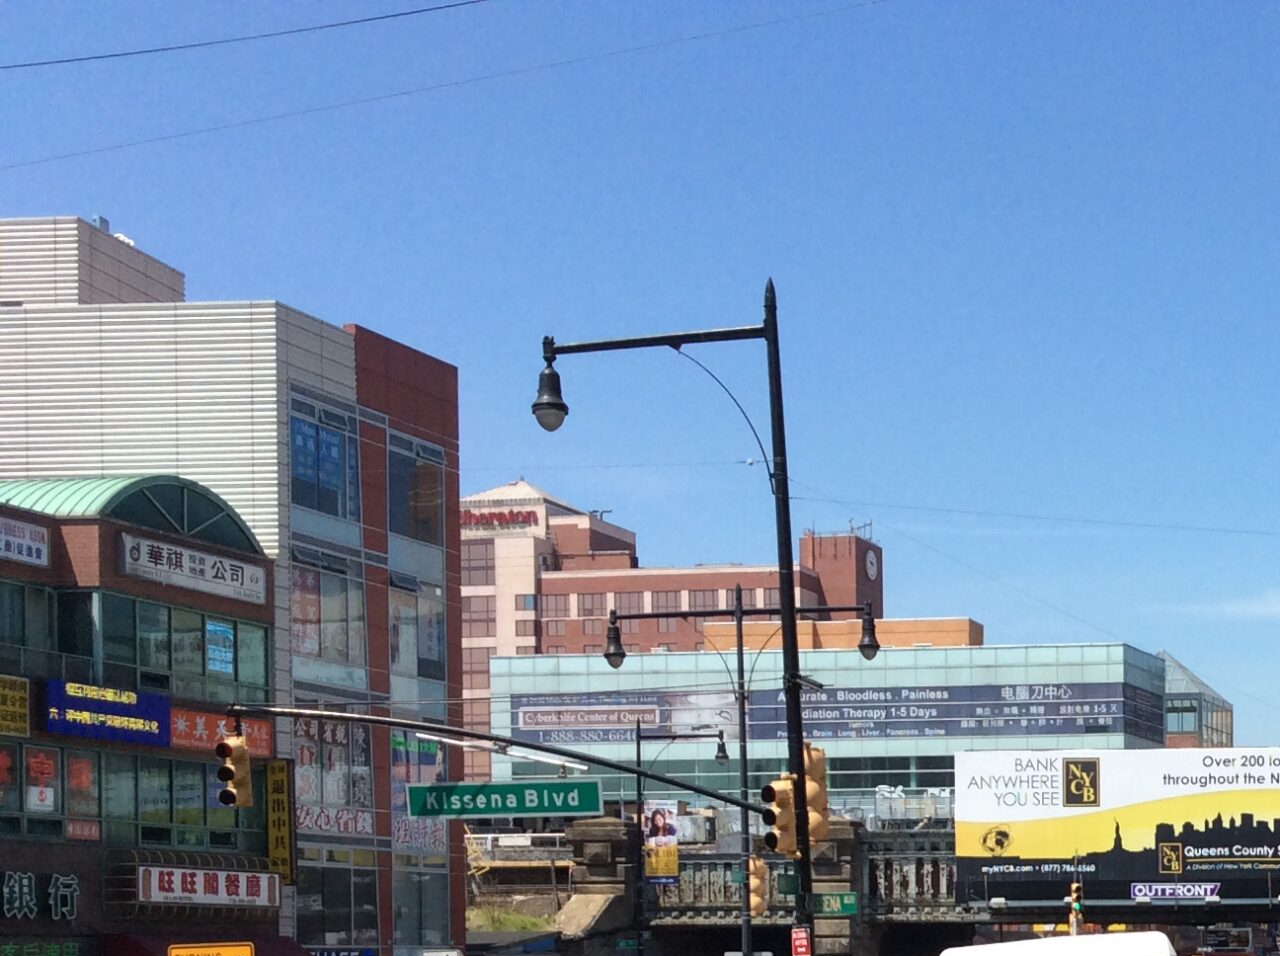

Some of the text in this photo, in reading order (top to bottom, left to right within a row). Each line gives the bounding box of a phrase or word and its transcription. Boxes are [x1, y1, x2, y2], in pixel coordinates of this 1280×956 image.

[777, 689, 949, 701] Aurate Bloodless Painless
[577, 712, 608, 722] Center
[609, 711, 618, 721] of
[802, 707, 938, 720] diation Therapy 1-5 Days
[1014, 757, 1059, 772] BANK
[1202, 755, 1236, 768] Over
[1240, 754, 1265, 767] 200
[967, 775, 1060, 790] ANYWHERE
[1162, 773, 1240, 787] throughout
[1243, 772, 1266, 785] the
[426, 789, 580, 810] Kissena Blvd
[993, 791, 1060, 806] YOU SEE
[1184, 845, 1229, 858] Queens
[1232, 845, 1275, 858] County
[1040, 864, 1061, 873] (877)
[3, 871, 80, 920] 銀行
[1133, 884, 1215, 897] OUTFRONT
